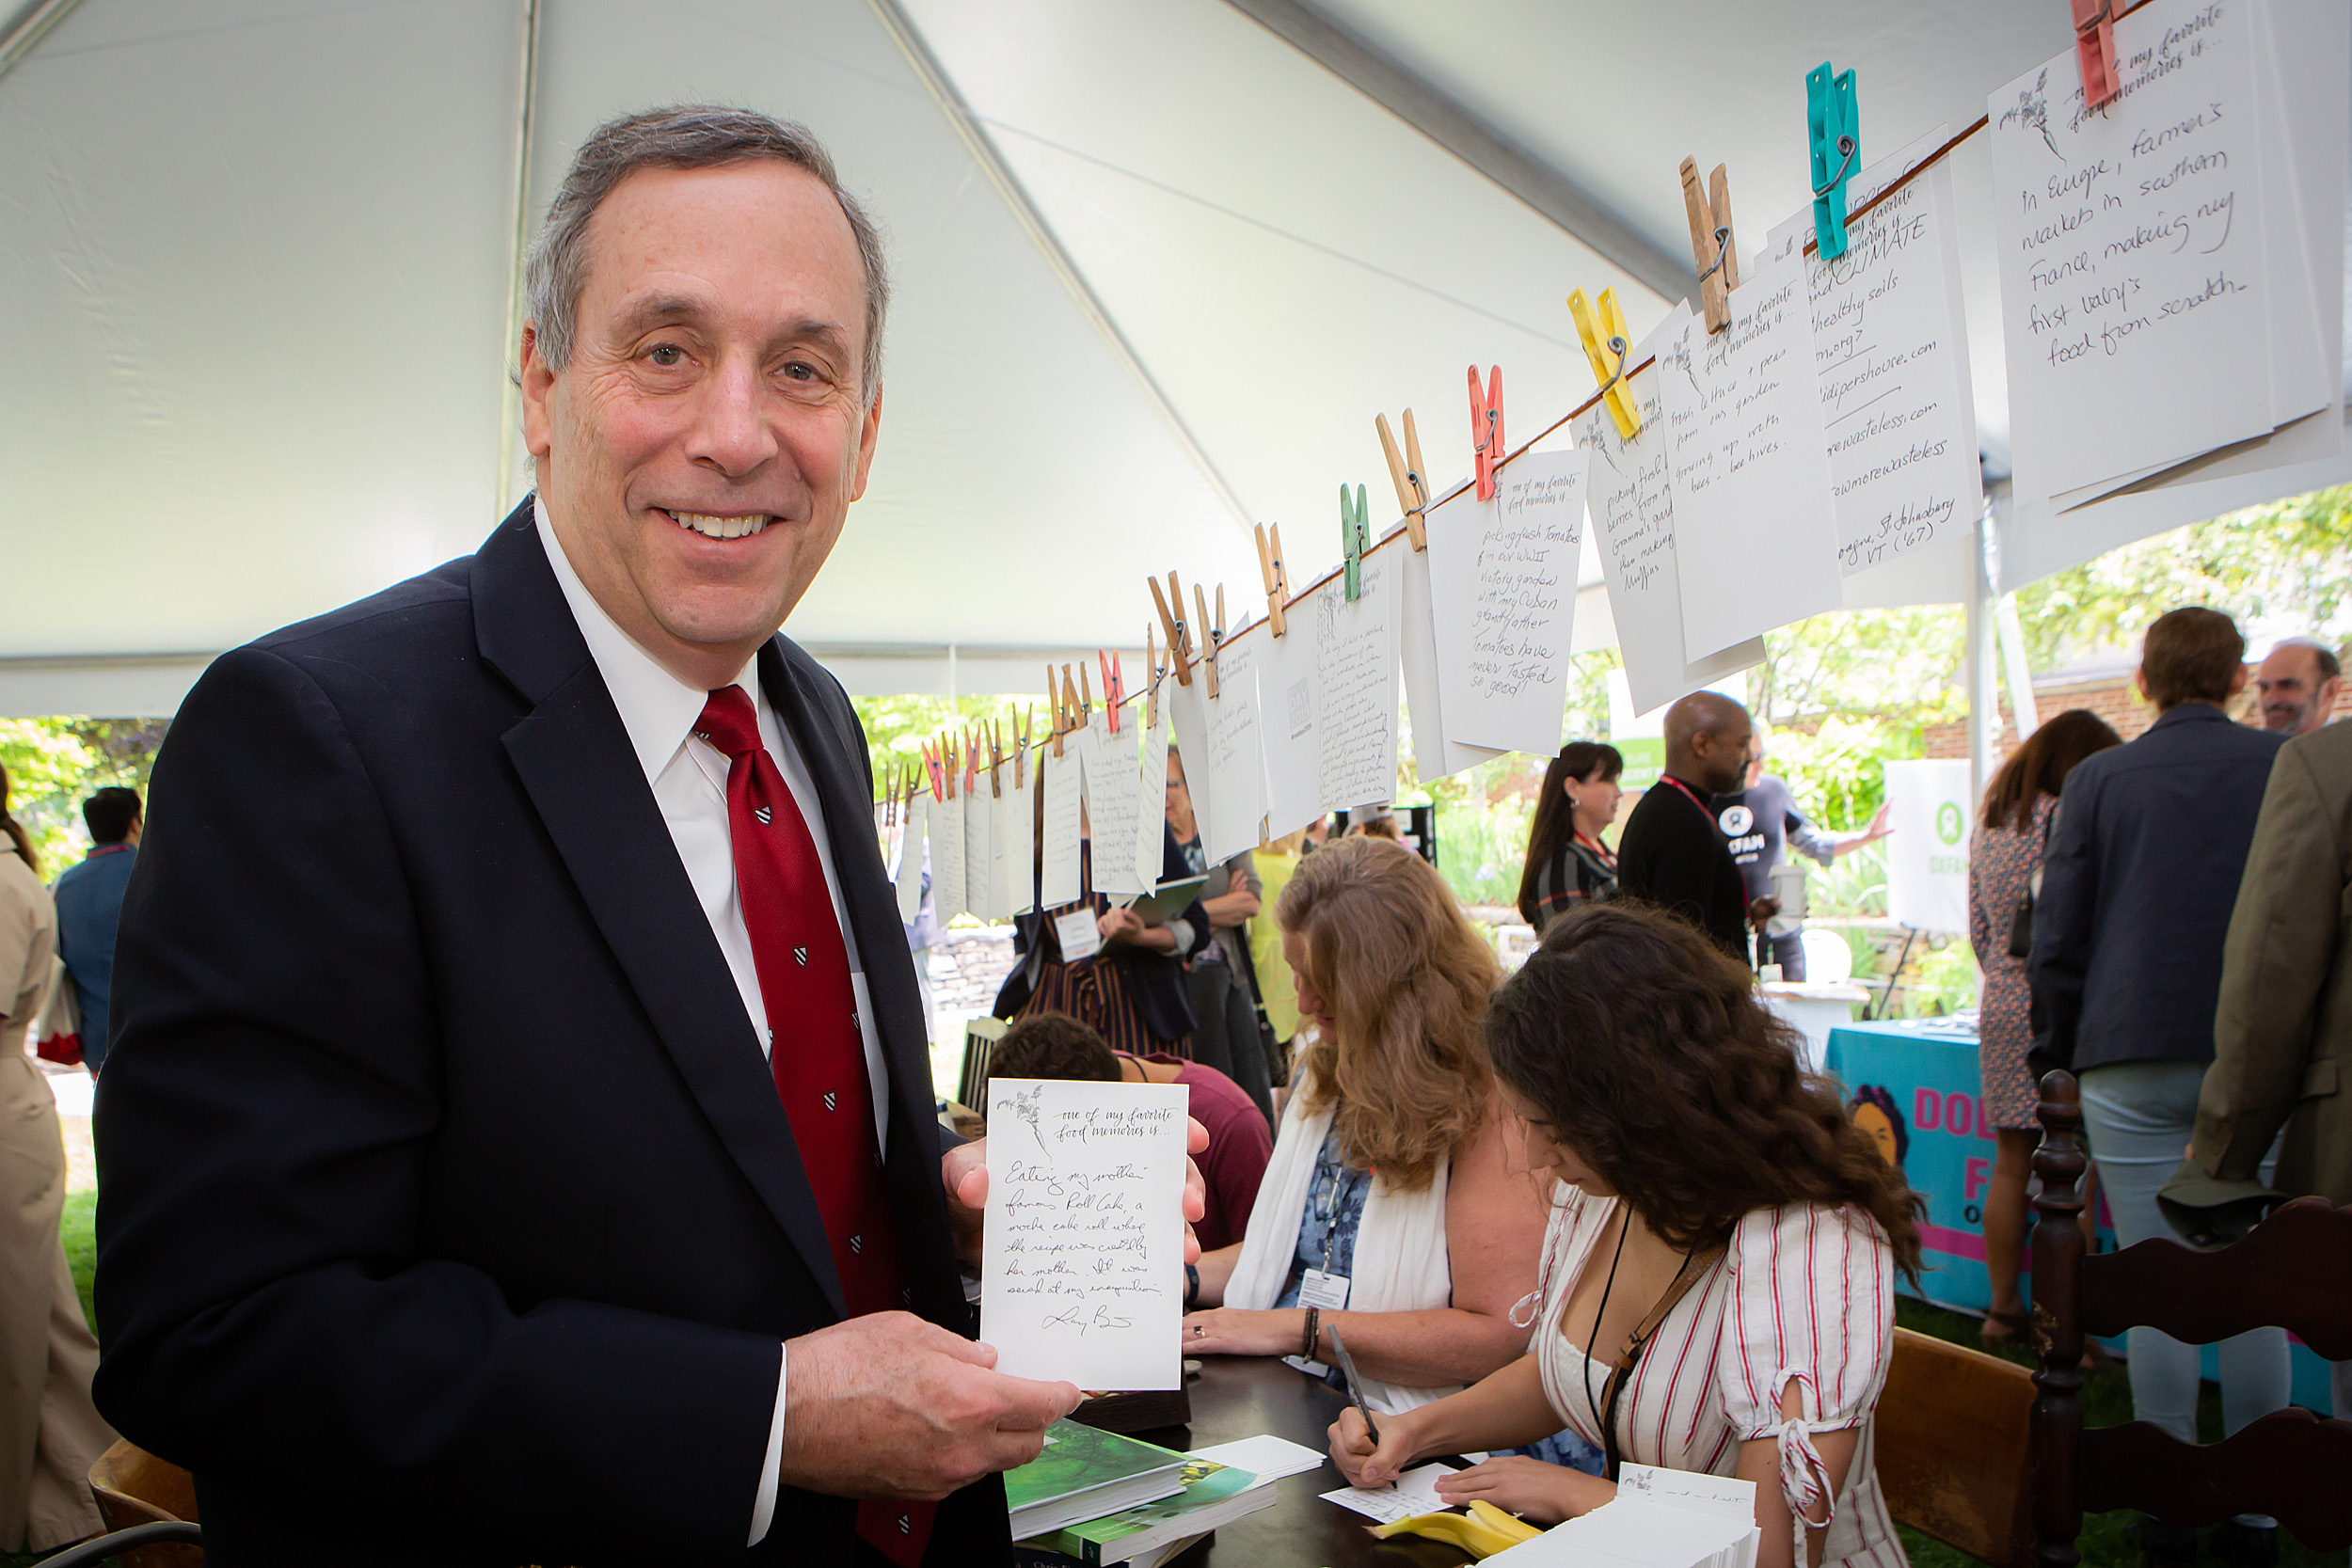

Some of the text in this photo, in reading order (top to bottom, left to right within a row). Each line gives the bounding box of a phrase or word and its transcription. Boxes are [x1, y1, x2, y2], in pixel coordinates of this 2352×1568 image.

[2158, 3, 2224, 58] favorite
[2103, 193, 2122, 211] in
[1836, 213, 1928, 286] CLIMATE
[1868, 268, 1899, 302] soils
[2046, 332, 2097, 368] food
[1867, 542, 1887, 565] VT
[1085, 1107, 1101, 1127] of
[1105, 1112, 1124, 1127] my
[1127, 1107, 1180, 1128] favorite
[1053, 1124, 1089, 1146] food
[1091, 1123, 1146, 1138] memories
[1135, 1200, 1144, 1212] a
